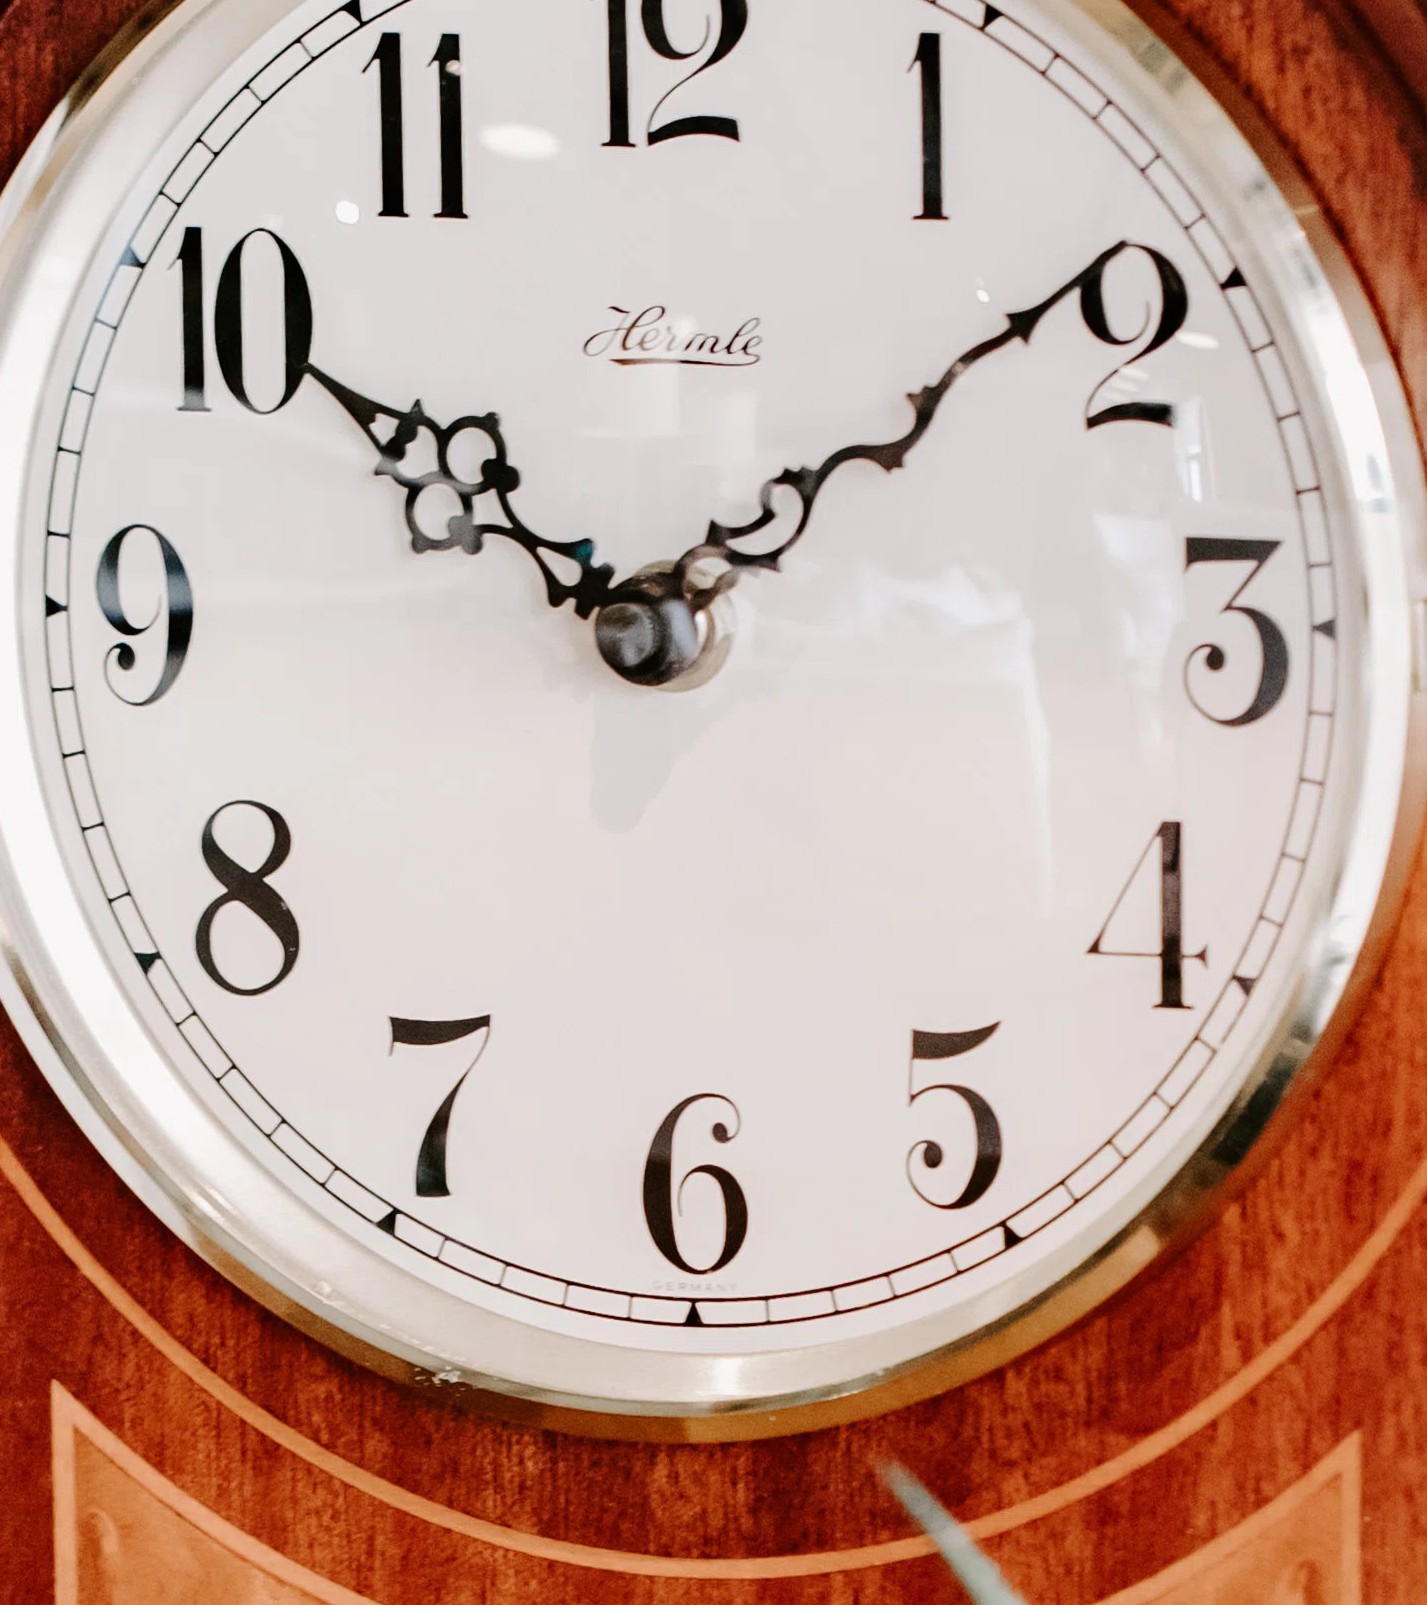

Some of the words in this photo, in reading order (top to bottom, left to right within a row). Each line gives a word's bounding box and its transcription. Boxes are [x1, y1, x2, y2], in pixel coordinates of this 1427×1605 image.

[361, 31, 470, 219] 11
[909, 31, 949, 220] 1
[167, 226, 314, 415] 10
[583, 306, 763, 366] Hermle
[1079, 240, 1189, 430] 2
[95, 524, 194, 707] 9
[1183, 537, 1290, 728] 3
[194, 799, 300, 996] 8
[1086, 821, 1209, 1009] 4
[388, 1013, 491, 1198] 7
[642, 1092, 749, 1276] 6
[906, 1020, 1004, 1211] 5
